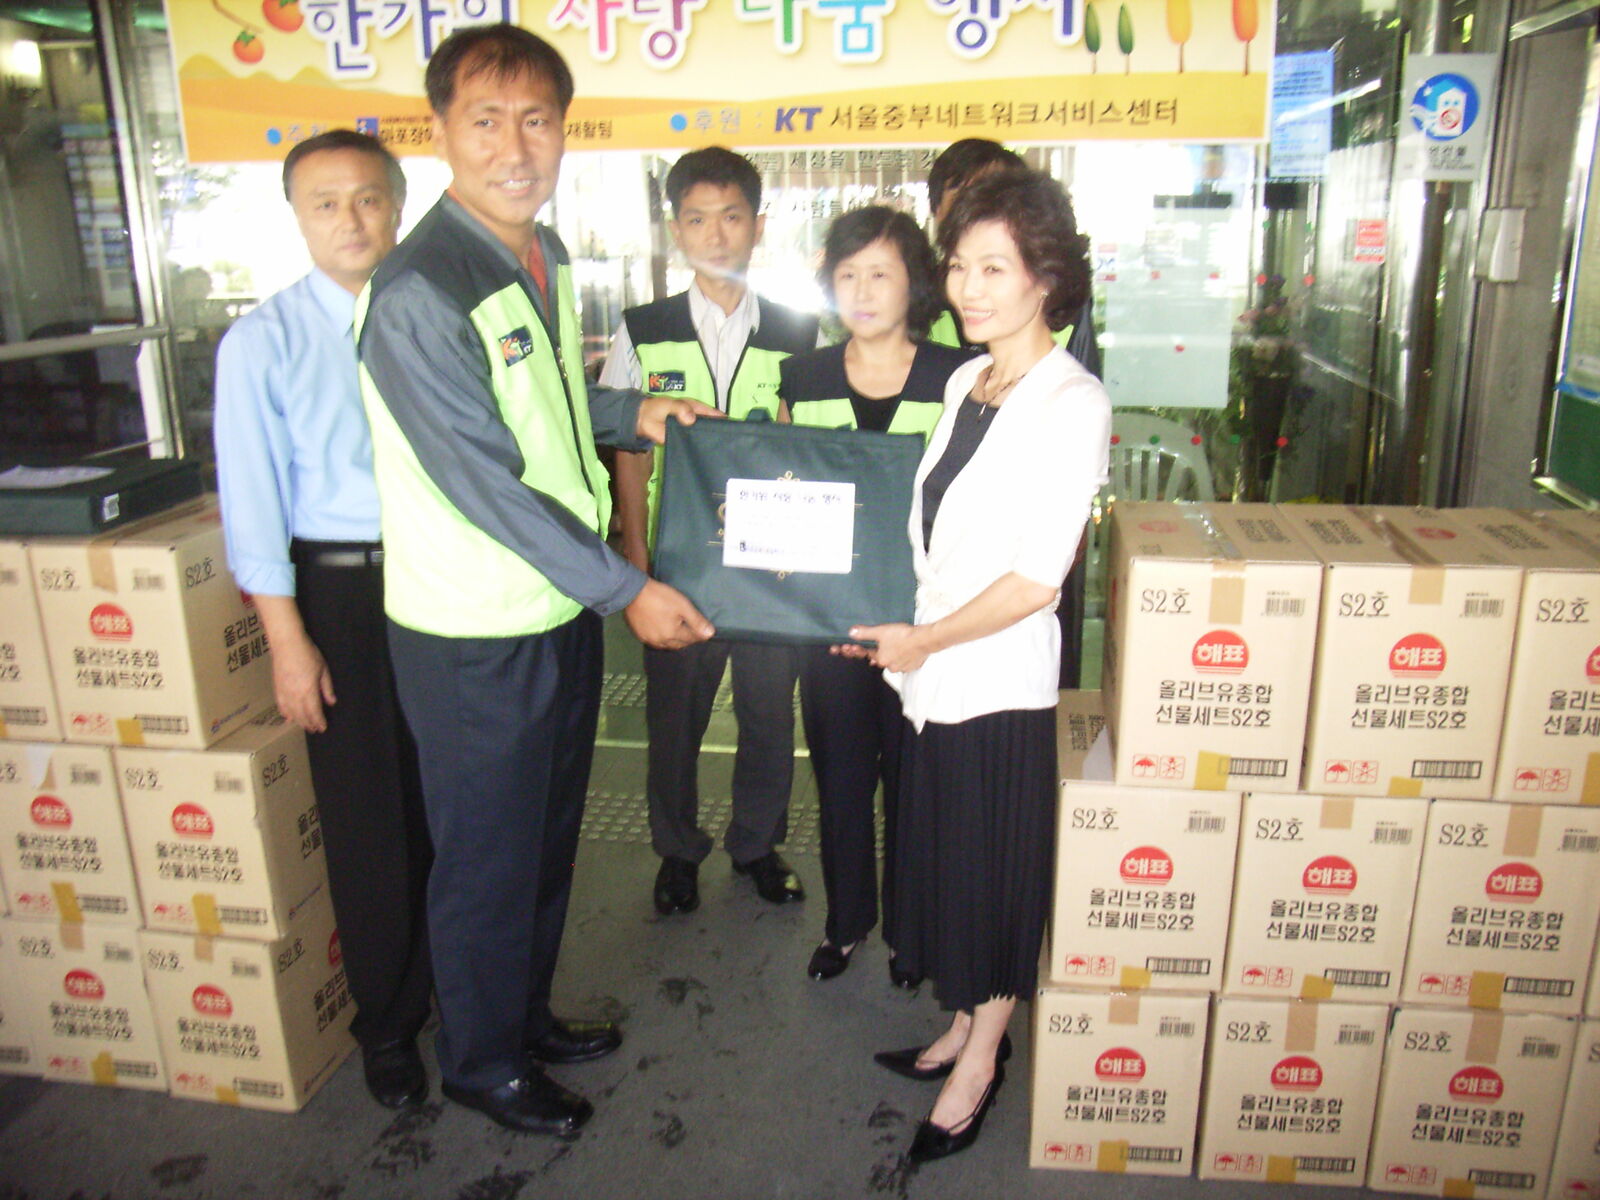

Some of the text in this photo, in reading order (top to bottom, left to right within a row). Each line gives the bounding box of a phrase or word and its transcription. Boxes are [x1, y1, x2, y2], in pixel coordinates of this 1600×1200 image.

[695, 107, 740, 133] 후원
[774, 107, 823, 132] KT
[830, 98, 1178, 131] 서울중부네트워크서비스센터
[185, 556, 217, 589] S2호
[1140, 588, 1192, 614] S2호
[1339, 591, 1390, 618] S2호
[1536, 597, 1590, 623] S2호
[1196, 644, 1245, 664] 해표
[1393, 647, 1442, 667] 해표
[1160, 679, 1274, 704] 올리브유종합
[1355, 683, 1470, 707] 올리브유종합
[1155, 705, 1272, 728] 선물세트S2호
[1351, 708, 1467, 729] 선물세트S2호
[262, 753, 290, 787] S2호
[1072, 807, 1119, 830] S2호
[1256, 818, 1304, 841] S2호
[1439, 823, 1488, 847] S2호
[1124, 858, 1168, 876] 해표
[1308, 867, 1353, 886] 해표
[1491, 873, 1539, 893] 해표
[1090, 888, 1196, 910] 올리브유종합
[1270, 899, 1378, 922] 올리브유종합
[1087, 911, 1194, 931] 선물세트S2호
[1451, 905, 1564, 930] 올리브유종합
[1266, 921, 1376, 944] 선물세트S2호
[1446, 927, 1560, 951] 선물세트S2호
[278, 937, 306, 974] S2호
[1048, 1013, 1093, 1035] S2호
[1226, 1021, 1272, 1043] S2호
[1404, 1031, 1452, 1052] S2호
[1100, 1057, 1142, 1075] 해표
[1275, 1066, 1318, 1083] 해표
[1067, 1084, 1168, 1105] 올리브유종합
[1453, 1076, 1500, 1094] 해표
[1064, 1105, 1167, 1124] 선물세트S2호
[1240, 1093, 1344, 1115] 올리브유종합
[1416, 1103, 1524, 1128] 올리브유종합
[1237, 1113, 1341, 1134] 선물세트S2호
[1411, 1123, 1522, 1148] 선물세트S2호
